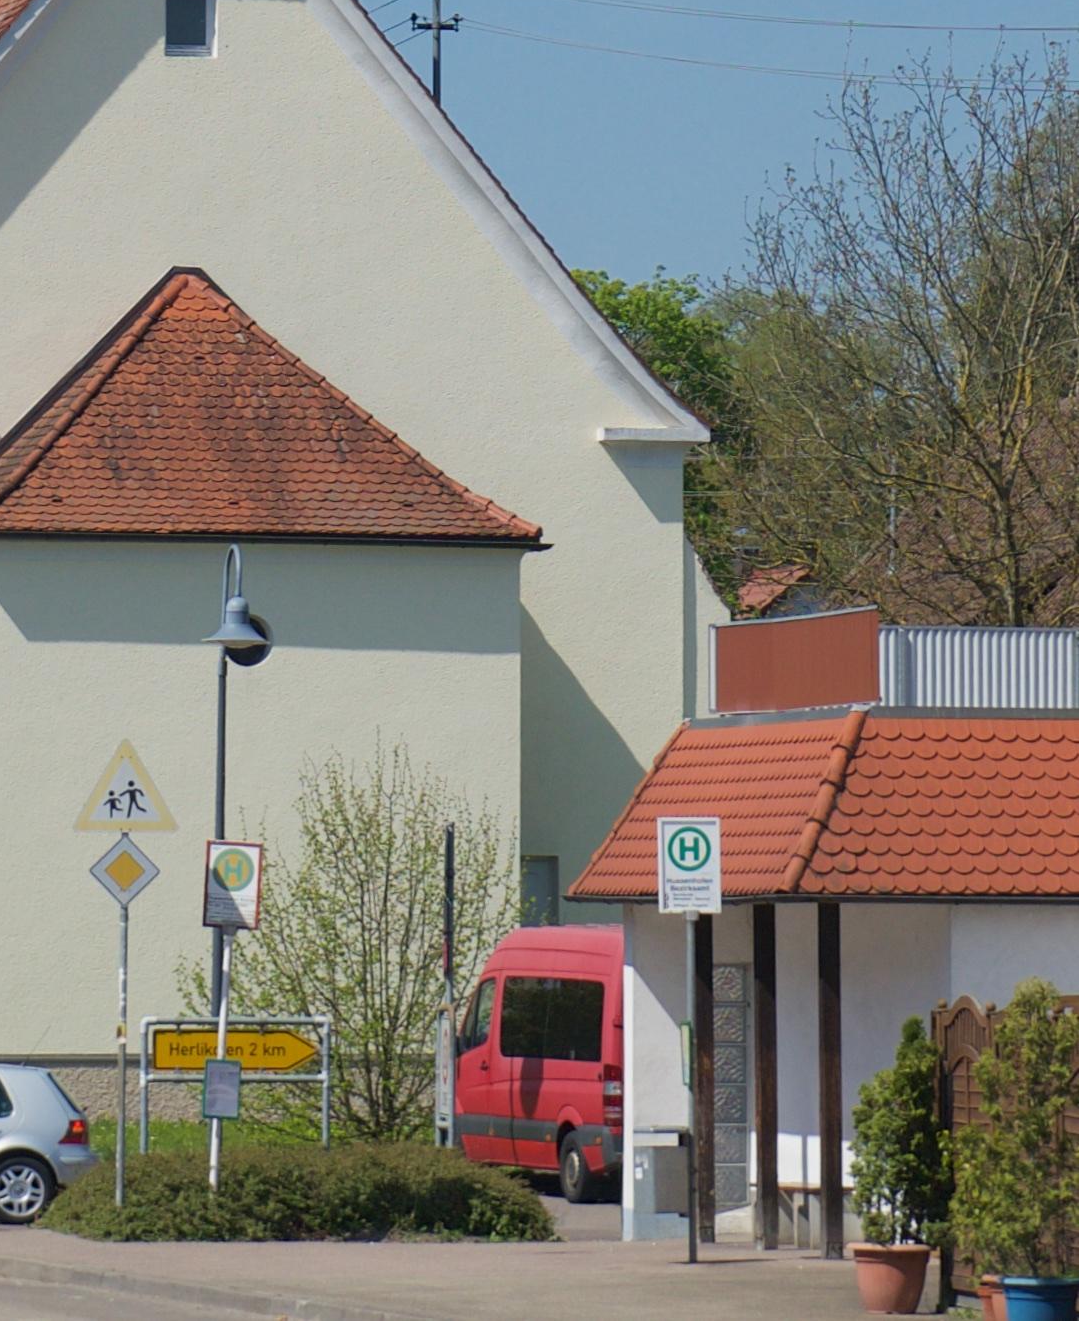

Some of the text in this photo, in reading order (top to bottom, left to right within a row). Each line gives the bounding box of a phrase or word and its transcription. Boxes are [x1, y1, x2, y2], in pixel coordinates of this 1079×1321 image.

[679, 836, 700, 861] H
[224, 858, 242, 882] H
[169, 1042, 286, 1057] Herlikoen 2 km
